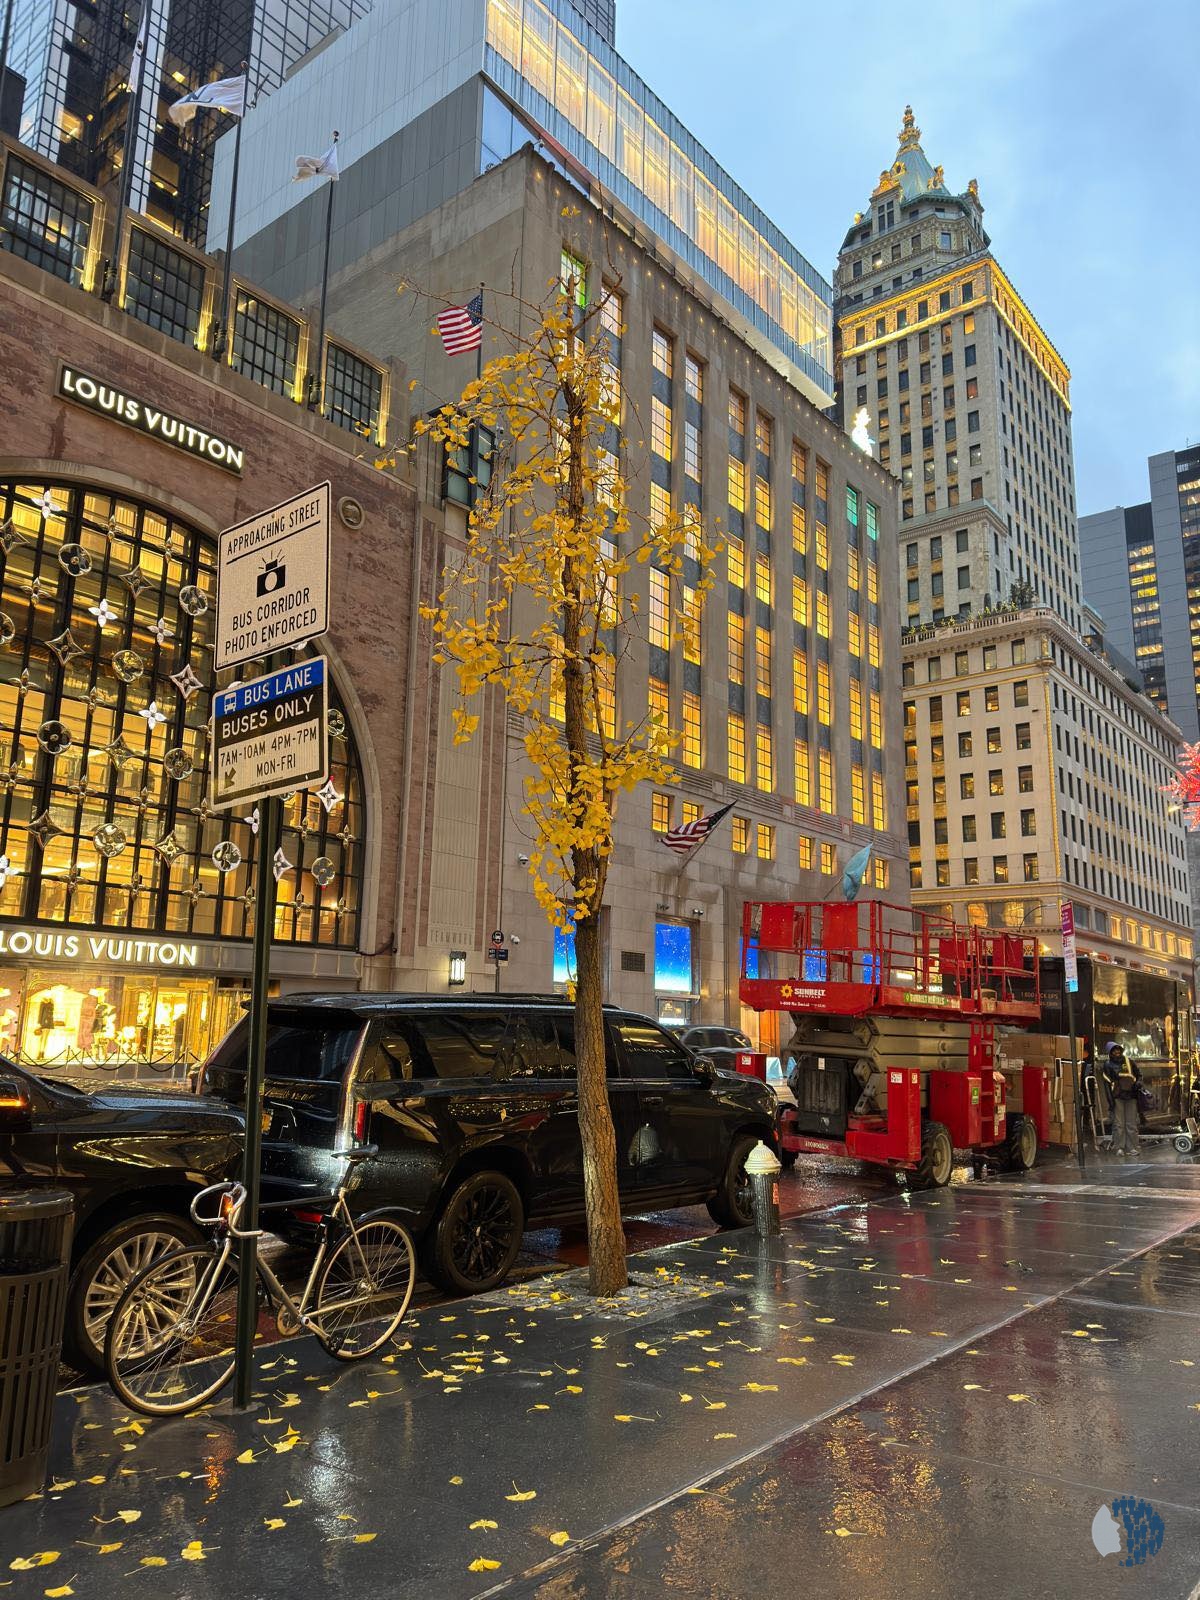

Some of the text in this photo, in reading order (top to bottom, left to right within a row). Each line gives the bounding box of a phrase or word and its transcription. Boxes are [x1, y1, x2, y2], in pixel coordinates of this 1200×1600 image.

[63, 370, 243, 469] LOUIS VUITTON
[227, 499, 321, 556] APPROACHING STREET
[232, 587, 310, 631] BUS CORRIDOR
[225, 608, 317, 656] PHOTO ENFORCED
[244, 667, 312, 706] BUS LANE
[222, 694, 314, 739] BUSES ONLY
[220, 726, 317, 767] 7AM-10AM 4PM-7PM
[256, 753, 296, 777] MON-FRI
[0, 930, 198, 966] LOUIS VUITTON
[794, 988, 826, 996] SUNBELT
